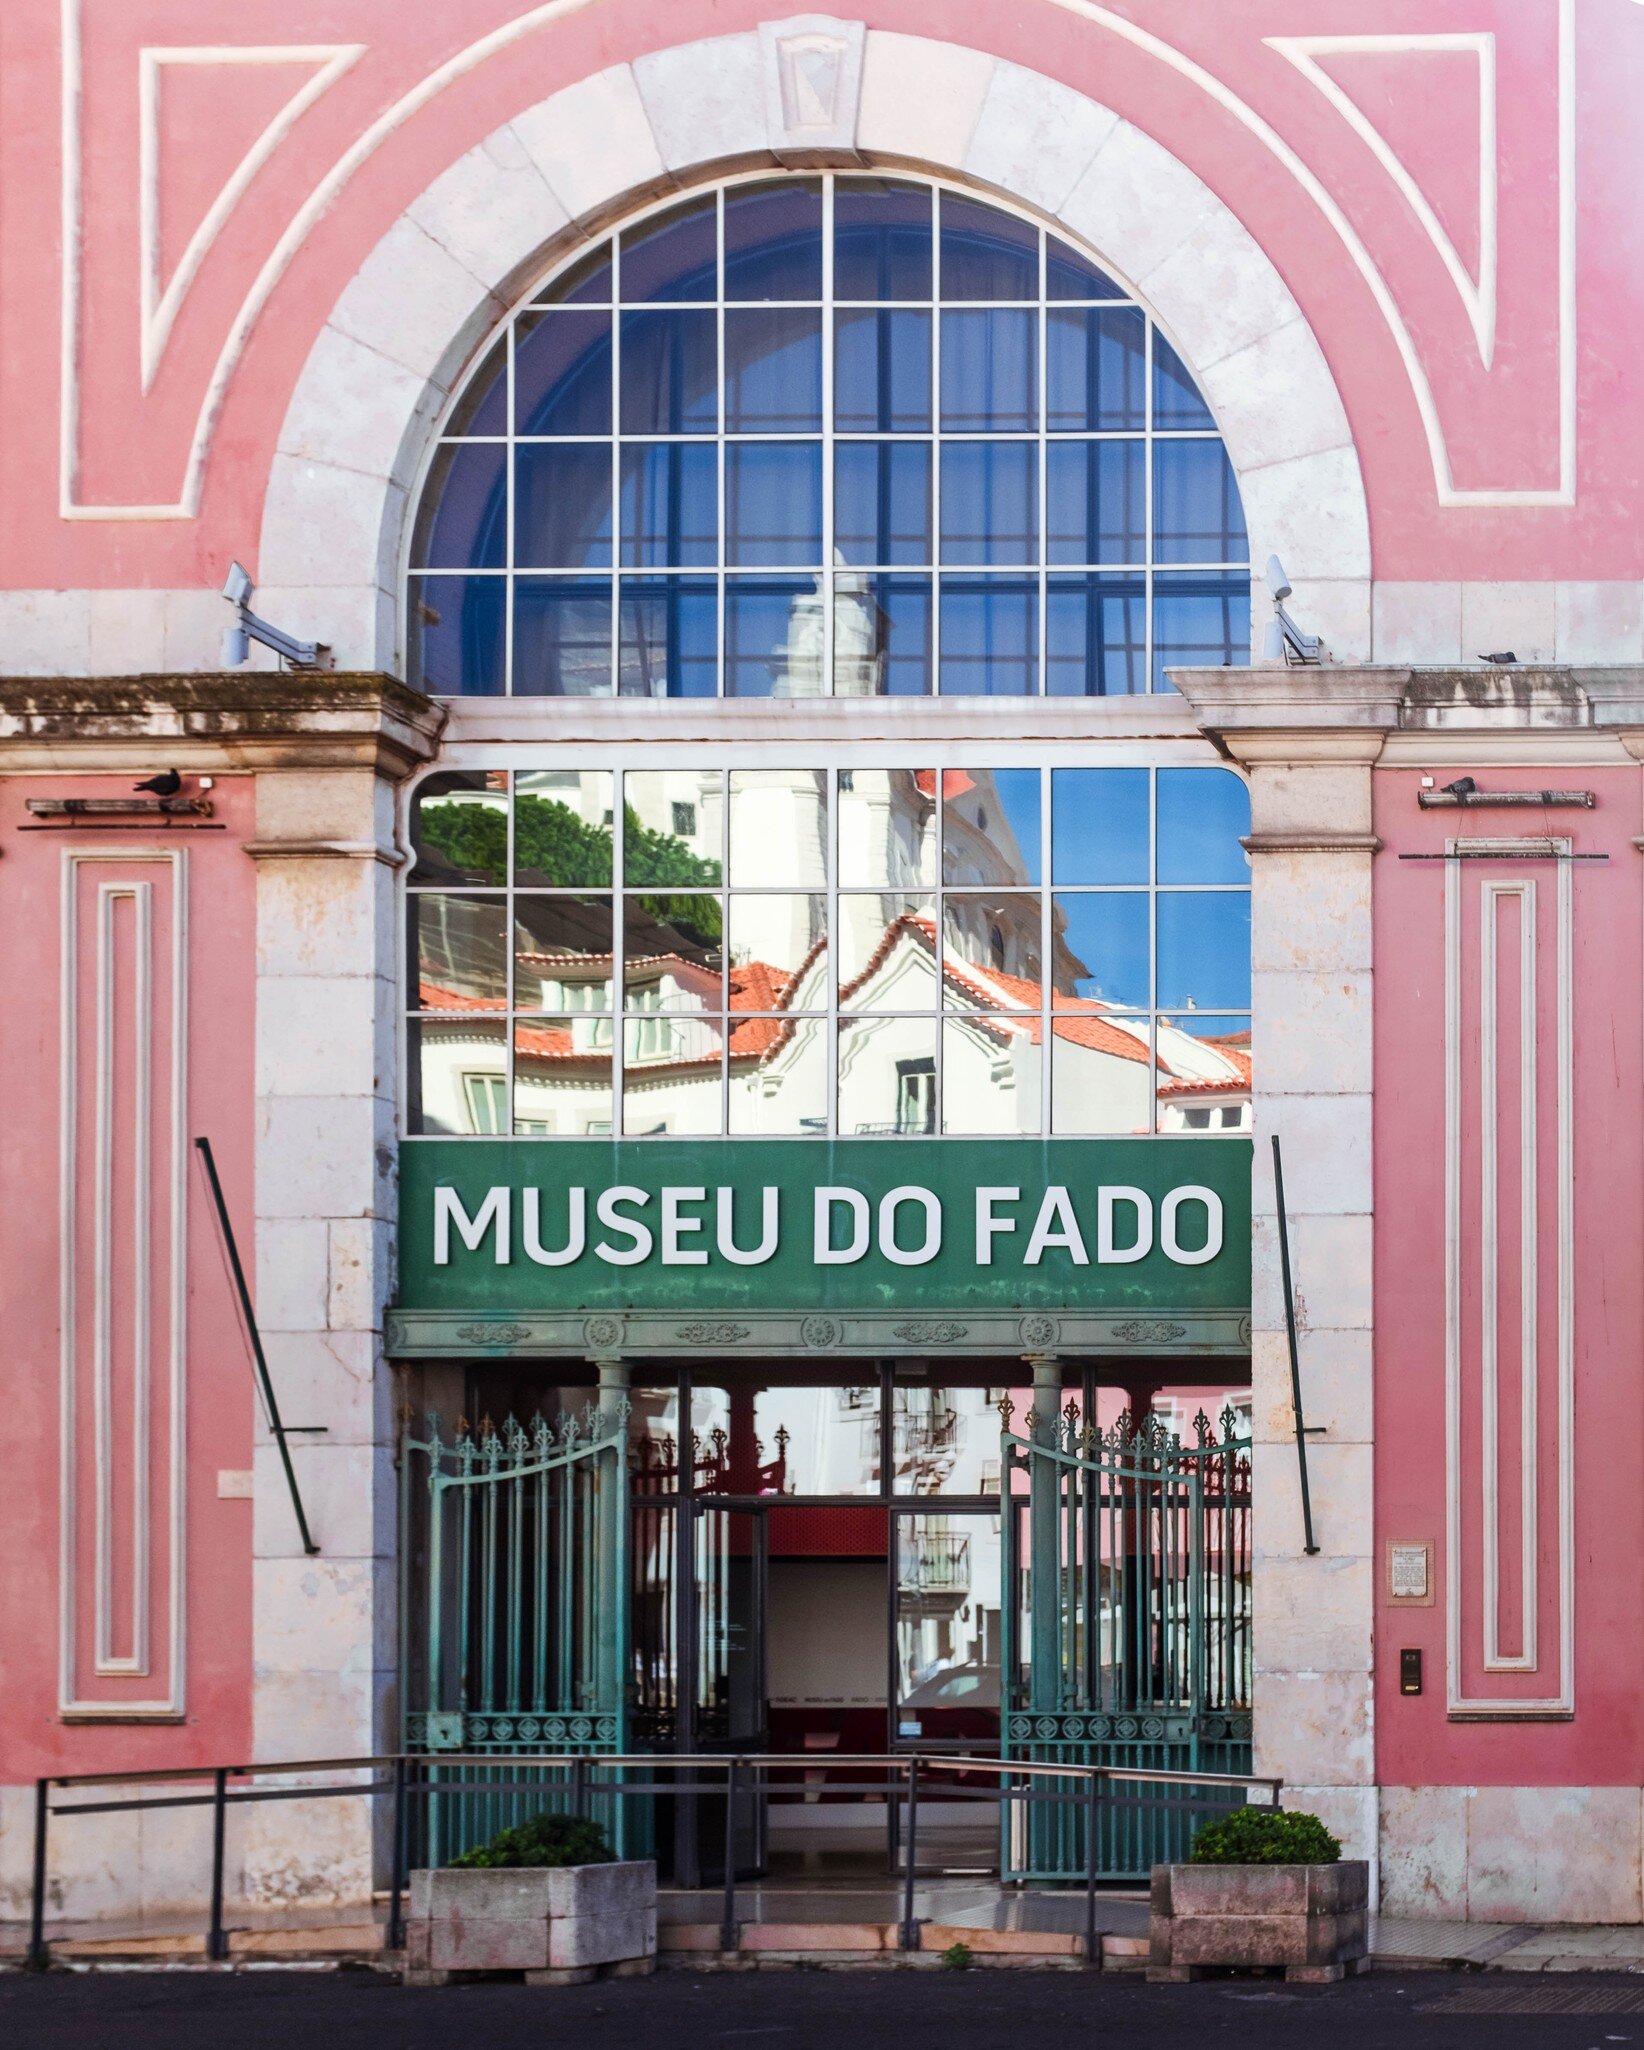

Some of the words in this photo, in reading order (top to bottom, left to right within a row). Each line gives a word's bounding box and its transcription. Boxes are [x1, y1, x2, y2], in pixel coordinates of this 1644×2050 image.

[433, 1186, 779, 1267] MUSEU
[813, 1186, 942, 1267] DO
[975, 1185, 1224, 1267] FADO
